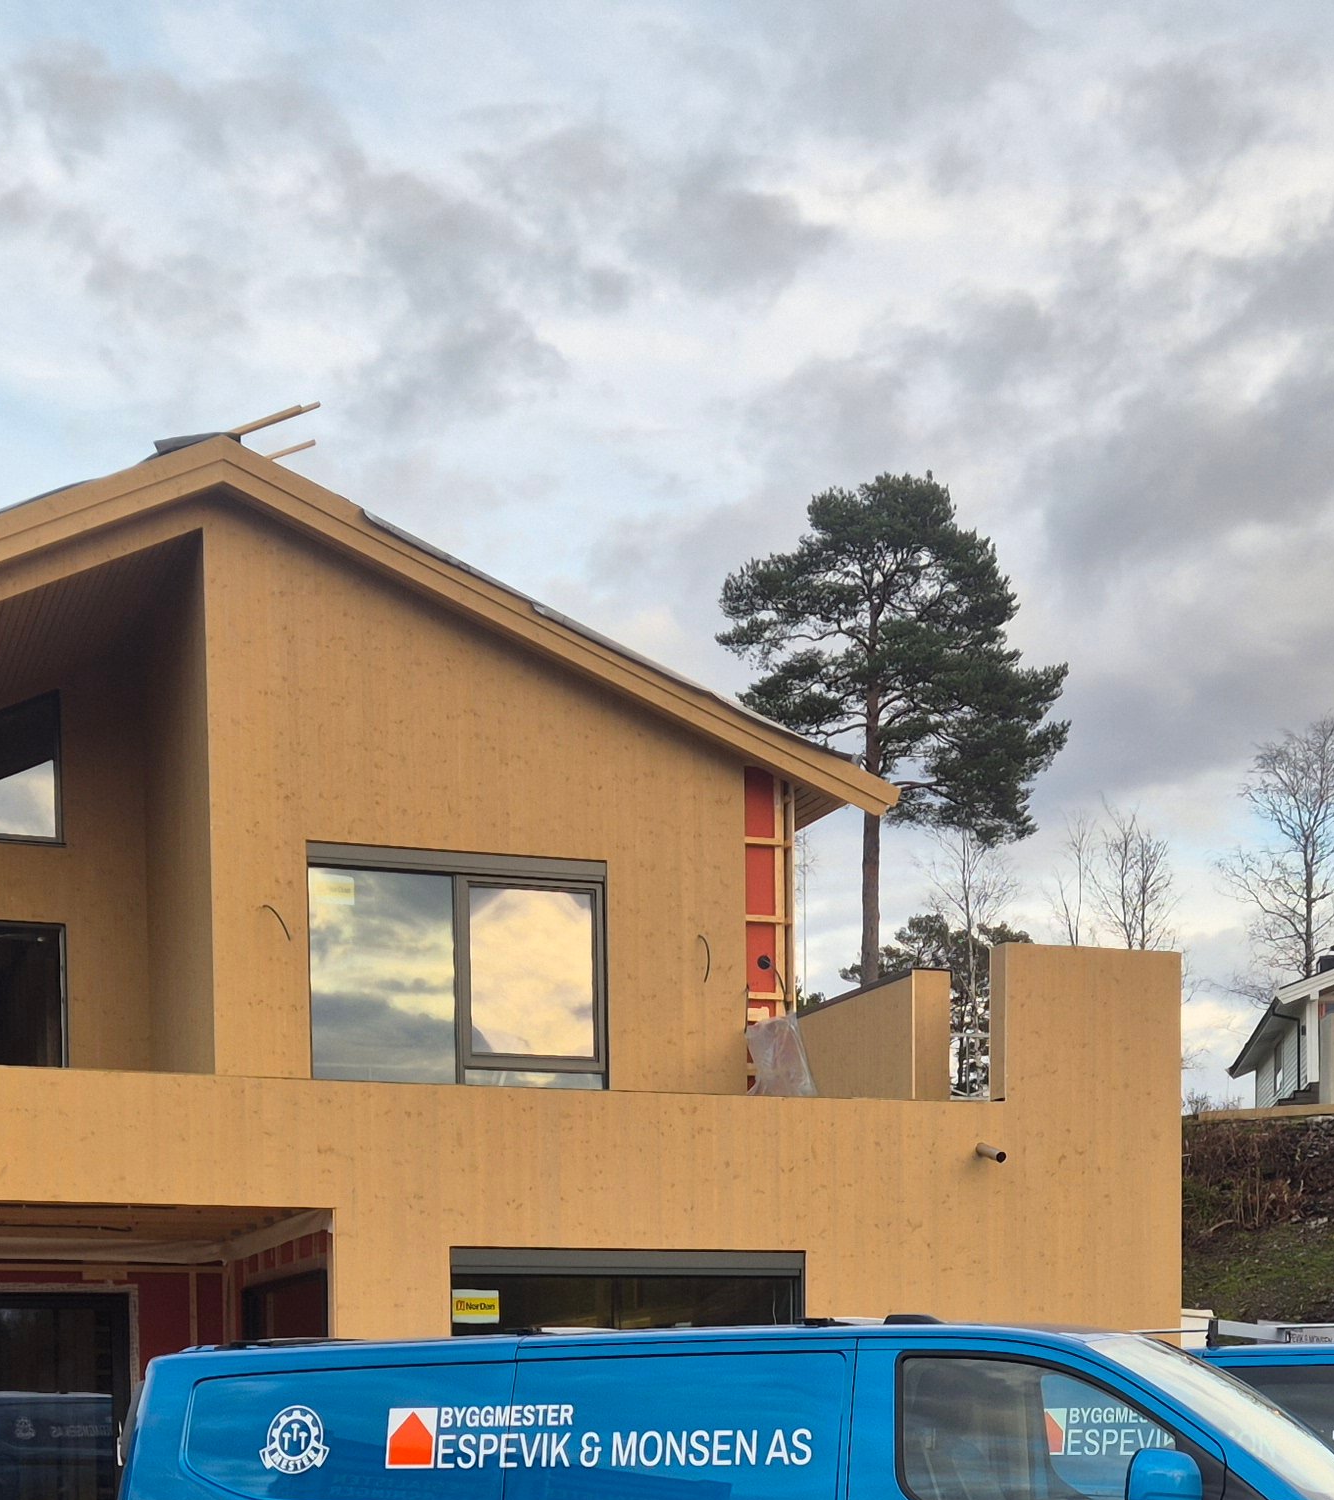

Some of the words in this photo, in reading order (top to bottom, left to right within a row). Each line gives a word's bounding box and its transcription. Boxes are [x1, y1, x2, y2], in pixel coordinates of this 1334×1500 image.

[439, 1404, 574, 1429] BYGGMESTER
[270, 1449, 318, 1472] MESTER
[436, 1432, 571, 1469] ESPEVIK
[579, 1432, 602, 1468] &
[610, 1429, 758, 1467] MONSEN
[764, 1427, 813, 1466] AS
